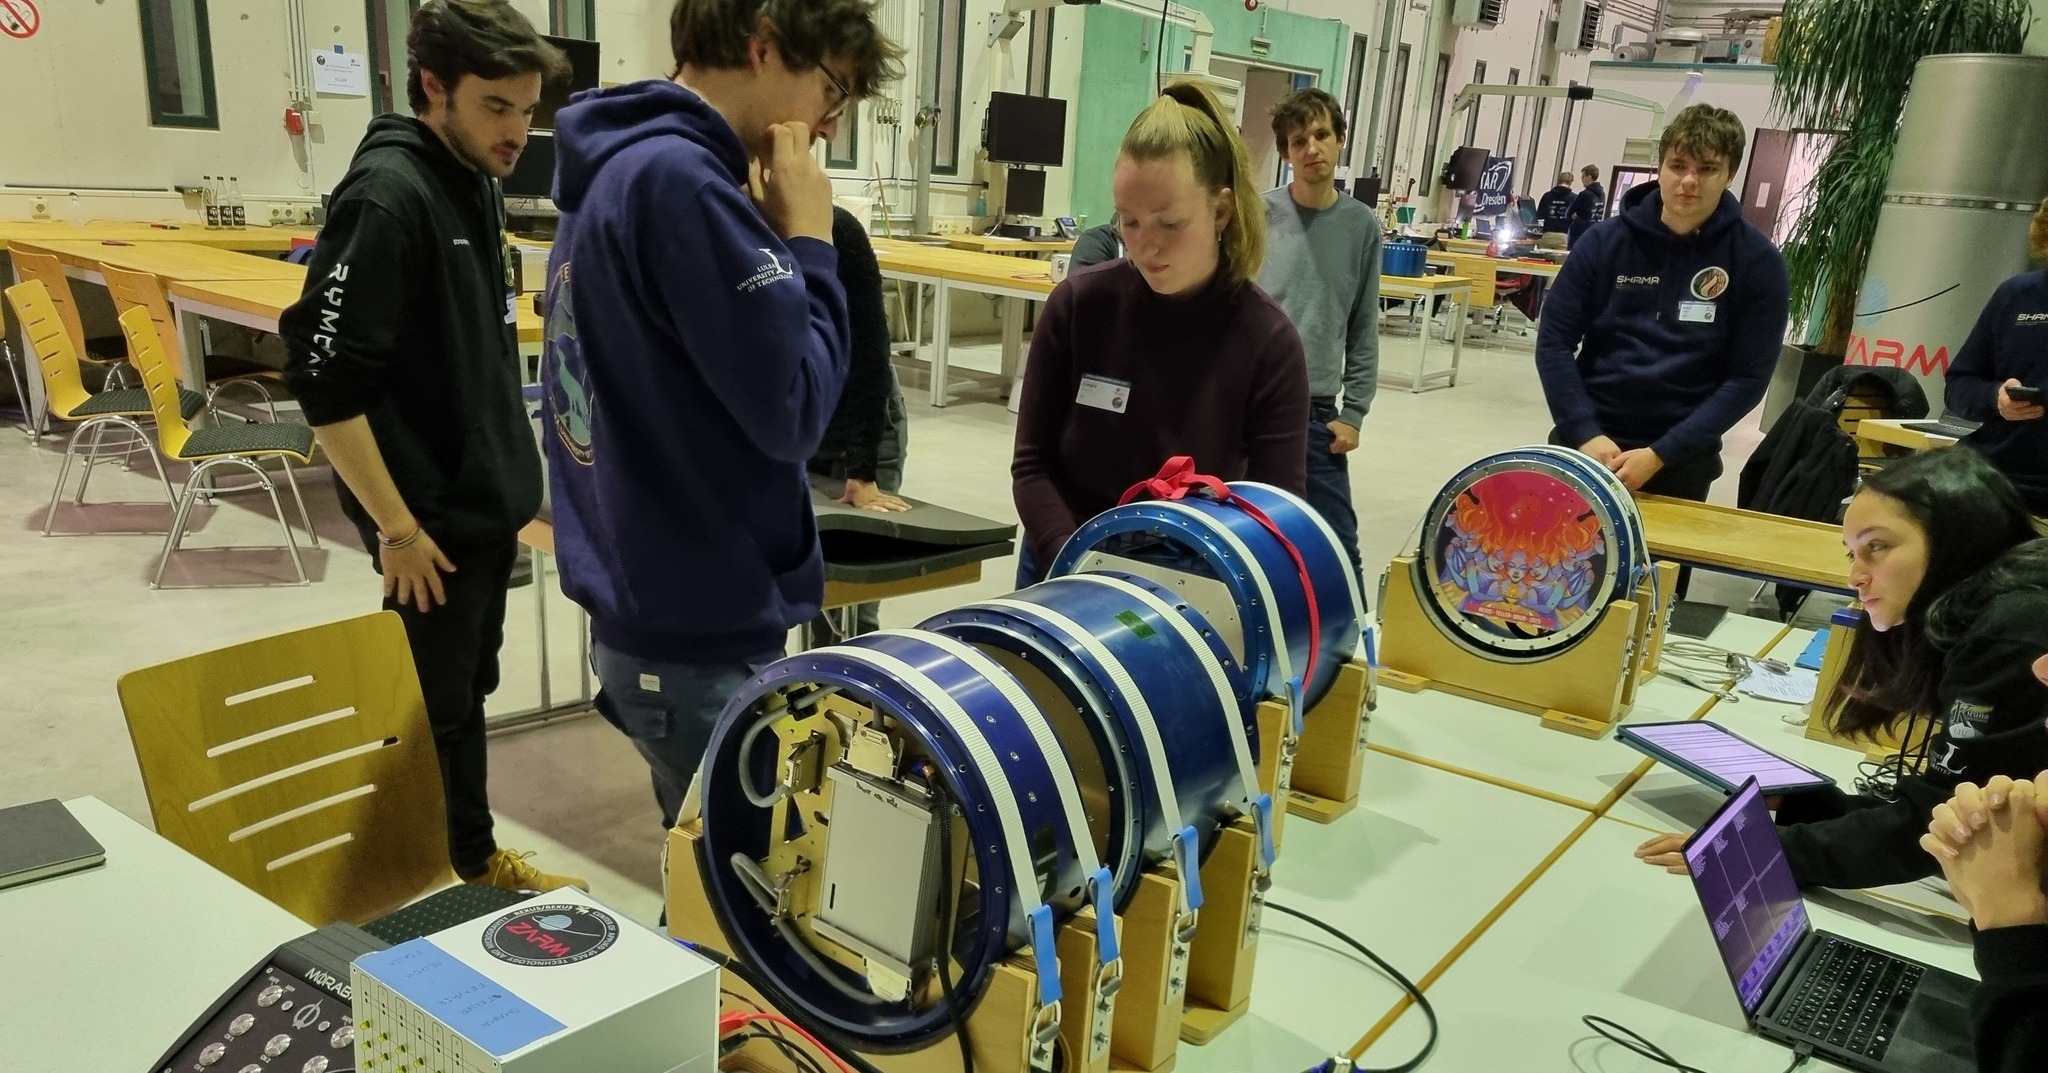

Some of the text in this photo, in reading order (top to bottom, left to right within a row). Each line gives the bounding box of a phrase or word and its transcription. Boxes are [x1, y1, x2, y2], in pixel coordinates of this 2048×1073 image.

[1482, 192, 1507, 206] Dresden
[737, 269, 776, 291] UNIVERSITY
[1616, 275, 1660, 285] SHAMA
[513, 904, 574, 916] REXUS/BEXUS
[504, 921, 571, 958] ZARM
[507, 957, 569, 966] TECHNOLOGY
